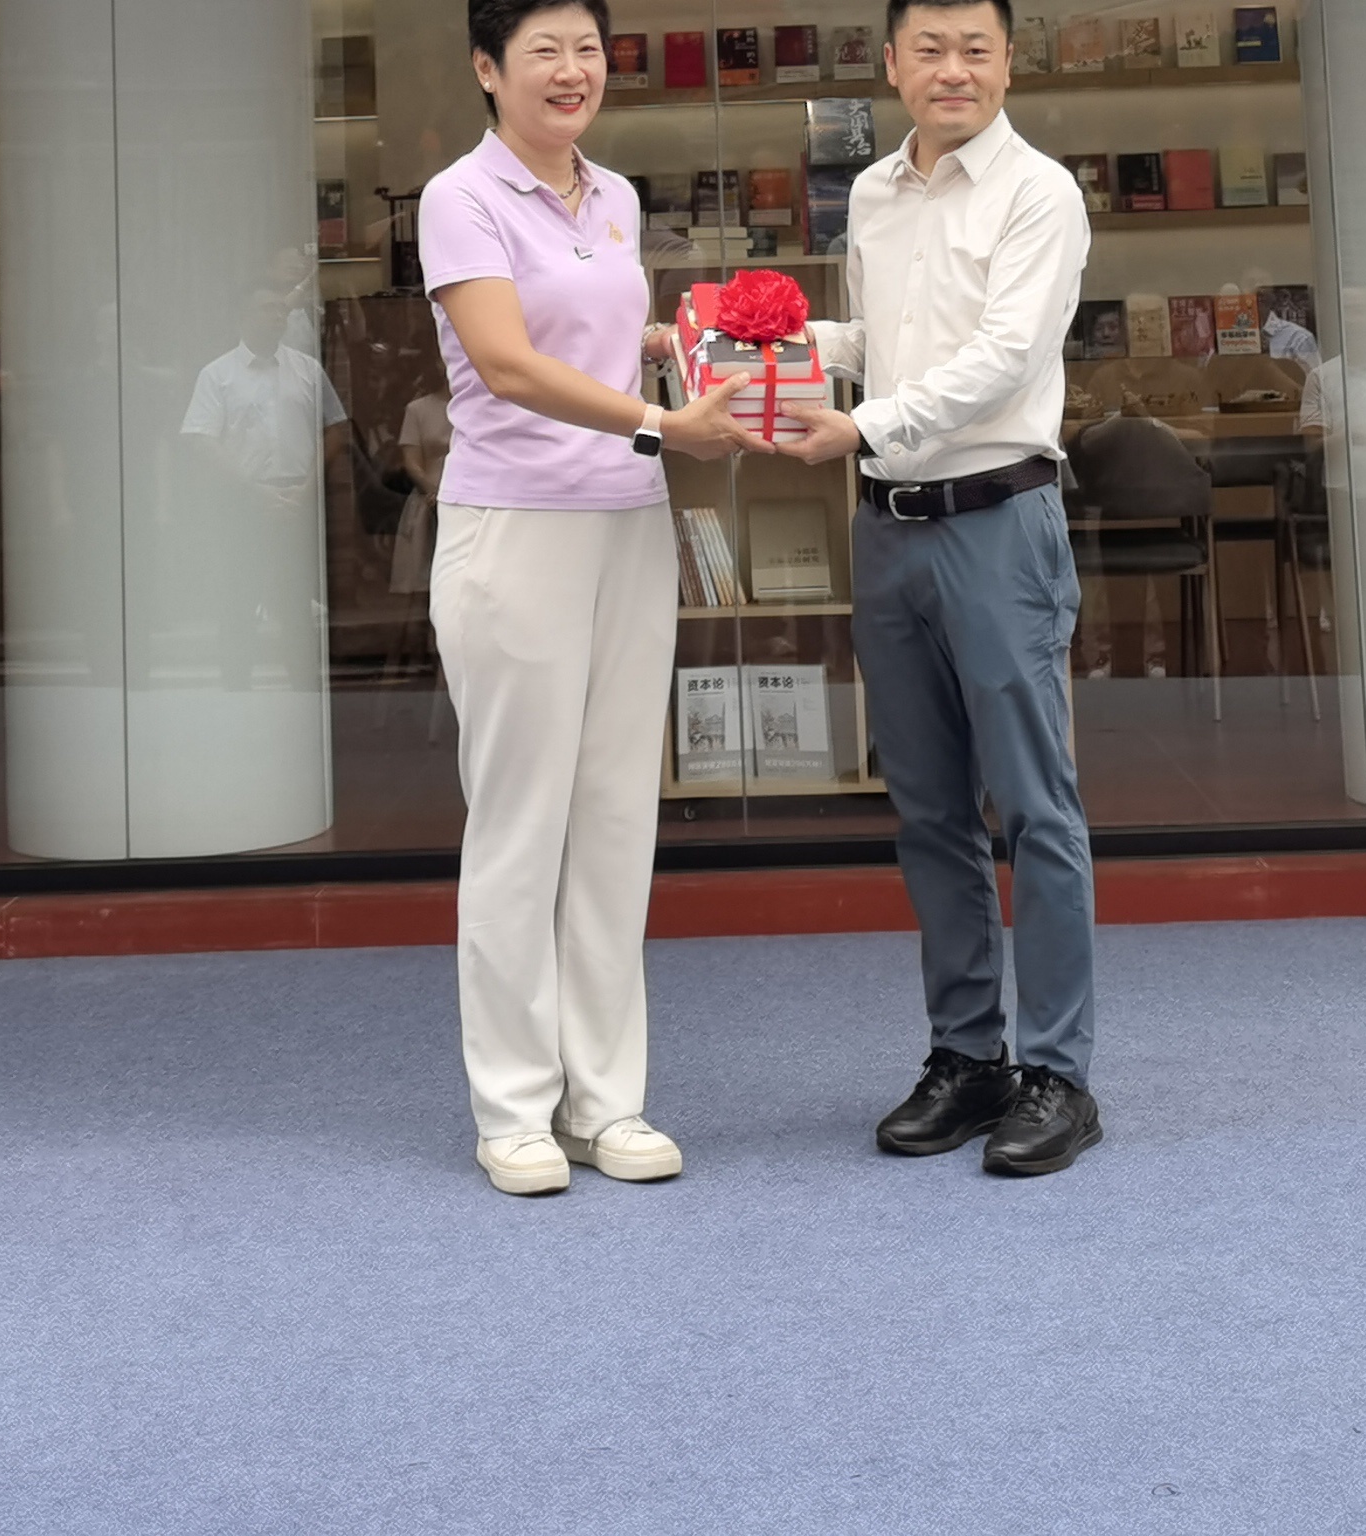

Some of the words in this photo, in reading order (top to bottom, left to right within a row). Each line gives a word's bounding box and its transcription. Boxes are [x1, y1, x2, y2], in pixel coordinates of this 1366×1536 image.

[687, 676, 726, 693] 资本论
[757, 675, 795, 690] 资本论
